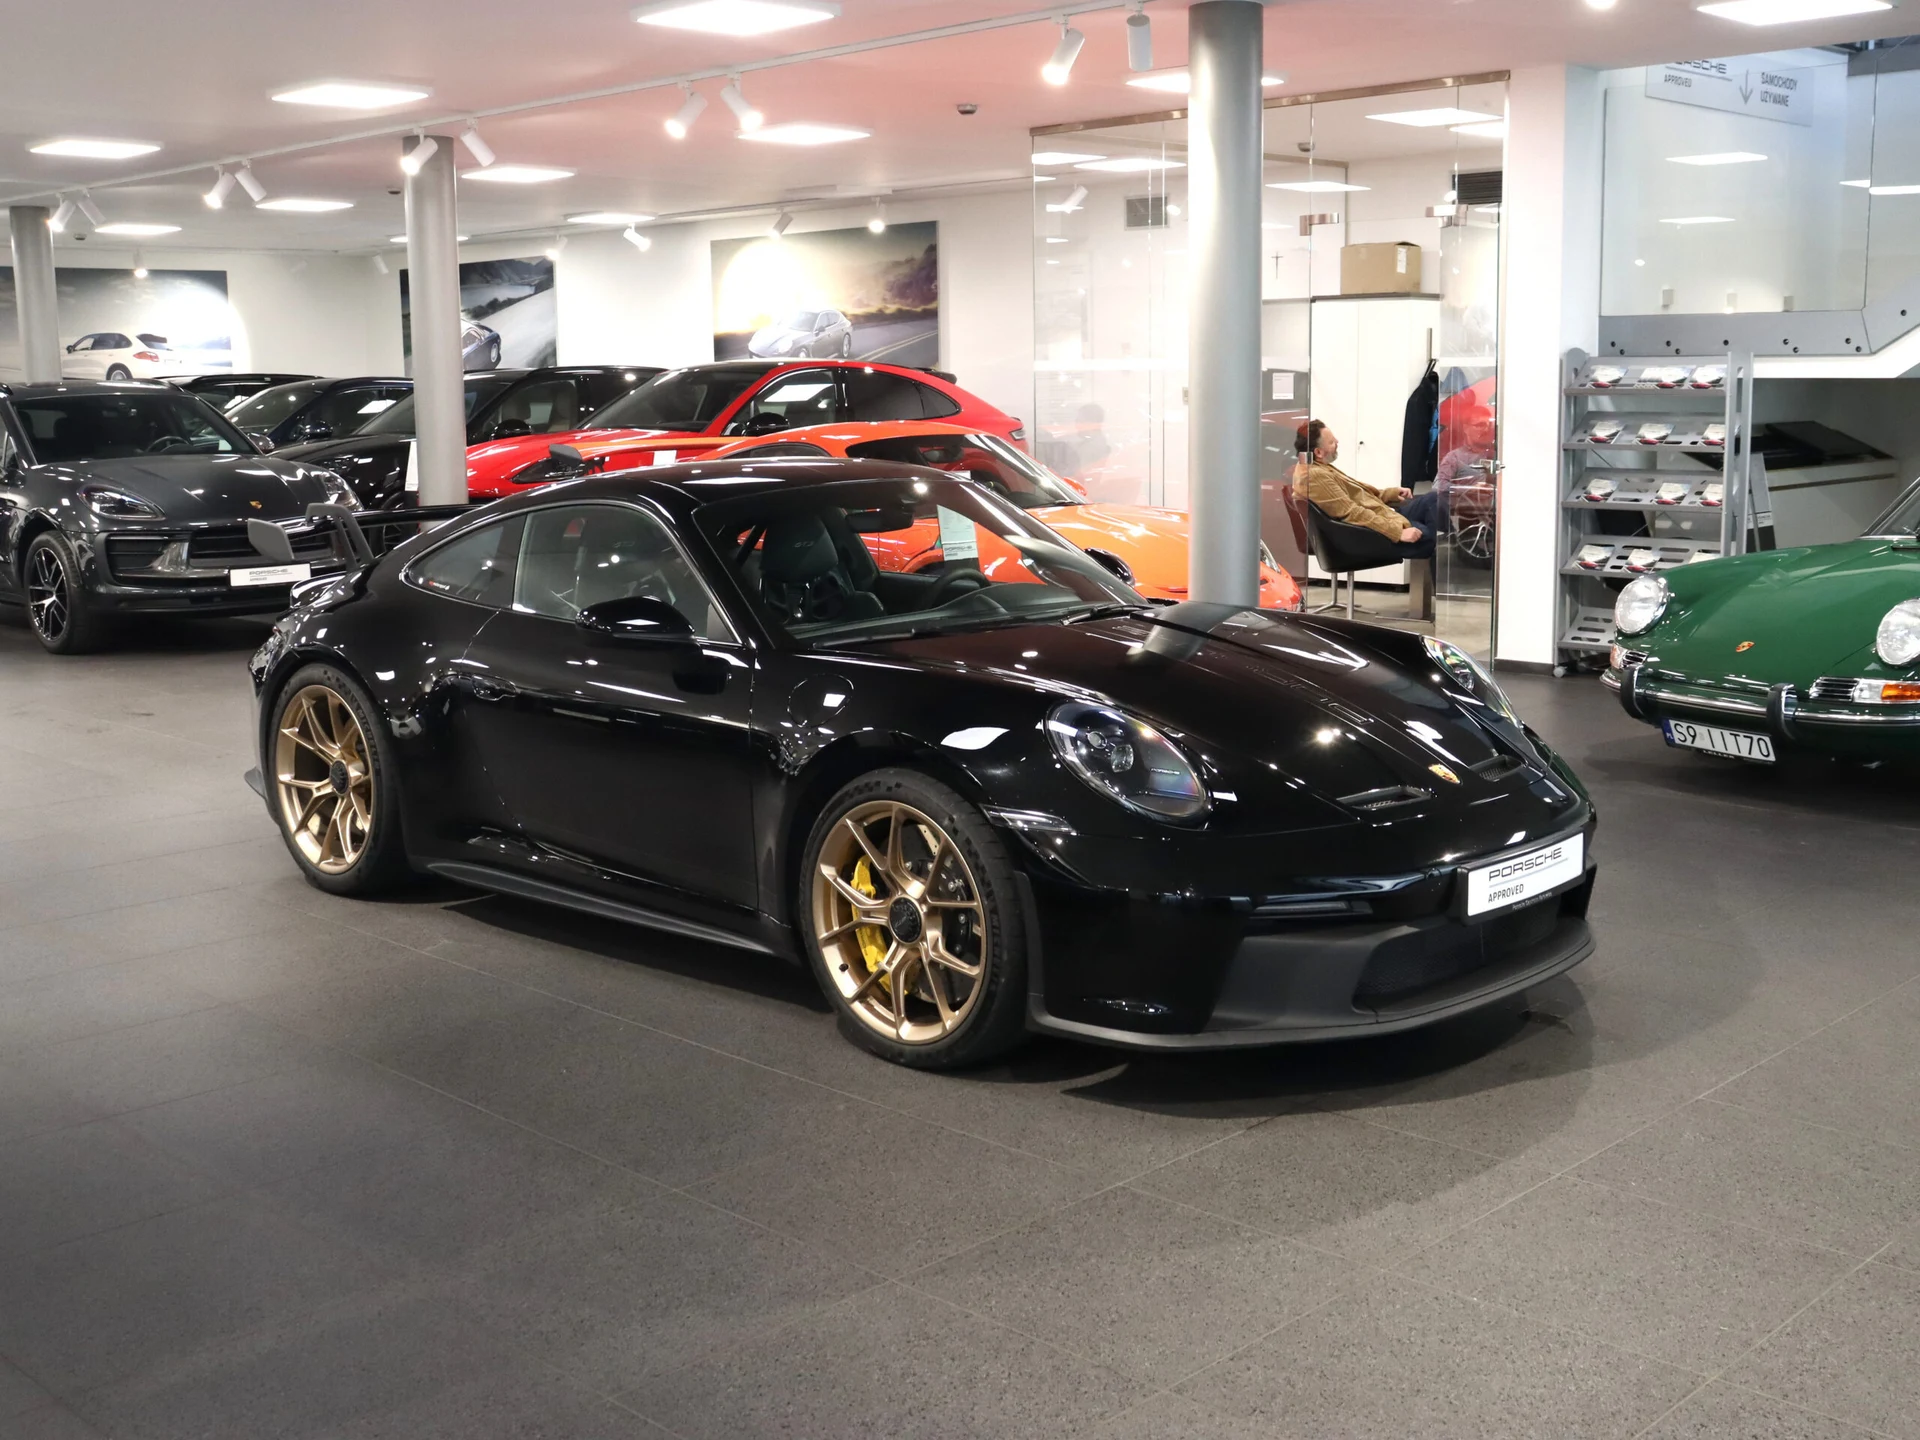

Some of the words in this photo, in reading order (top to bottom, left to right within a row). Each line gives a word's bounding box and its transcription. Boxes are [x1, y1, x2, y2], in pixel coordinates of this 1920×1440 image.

[1663, 73, 1693, 88] APPROVED
[1761, 71, 1798, 91] SAMOCHODY
[1674, 723, 1697, 745] S9
[1488, 847, 1563, 882] PORSCHE
[1487, 883, 1524, 903] APPROVED
